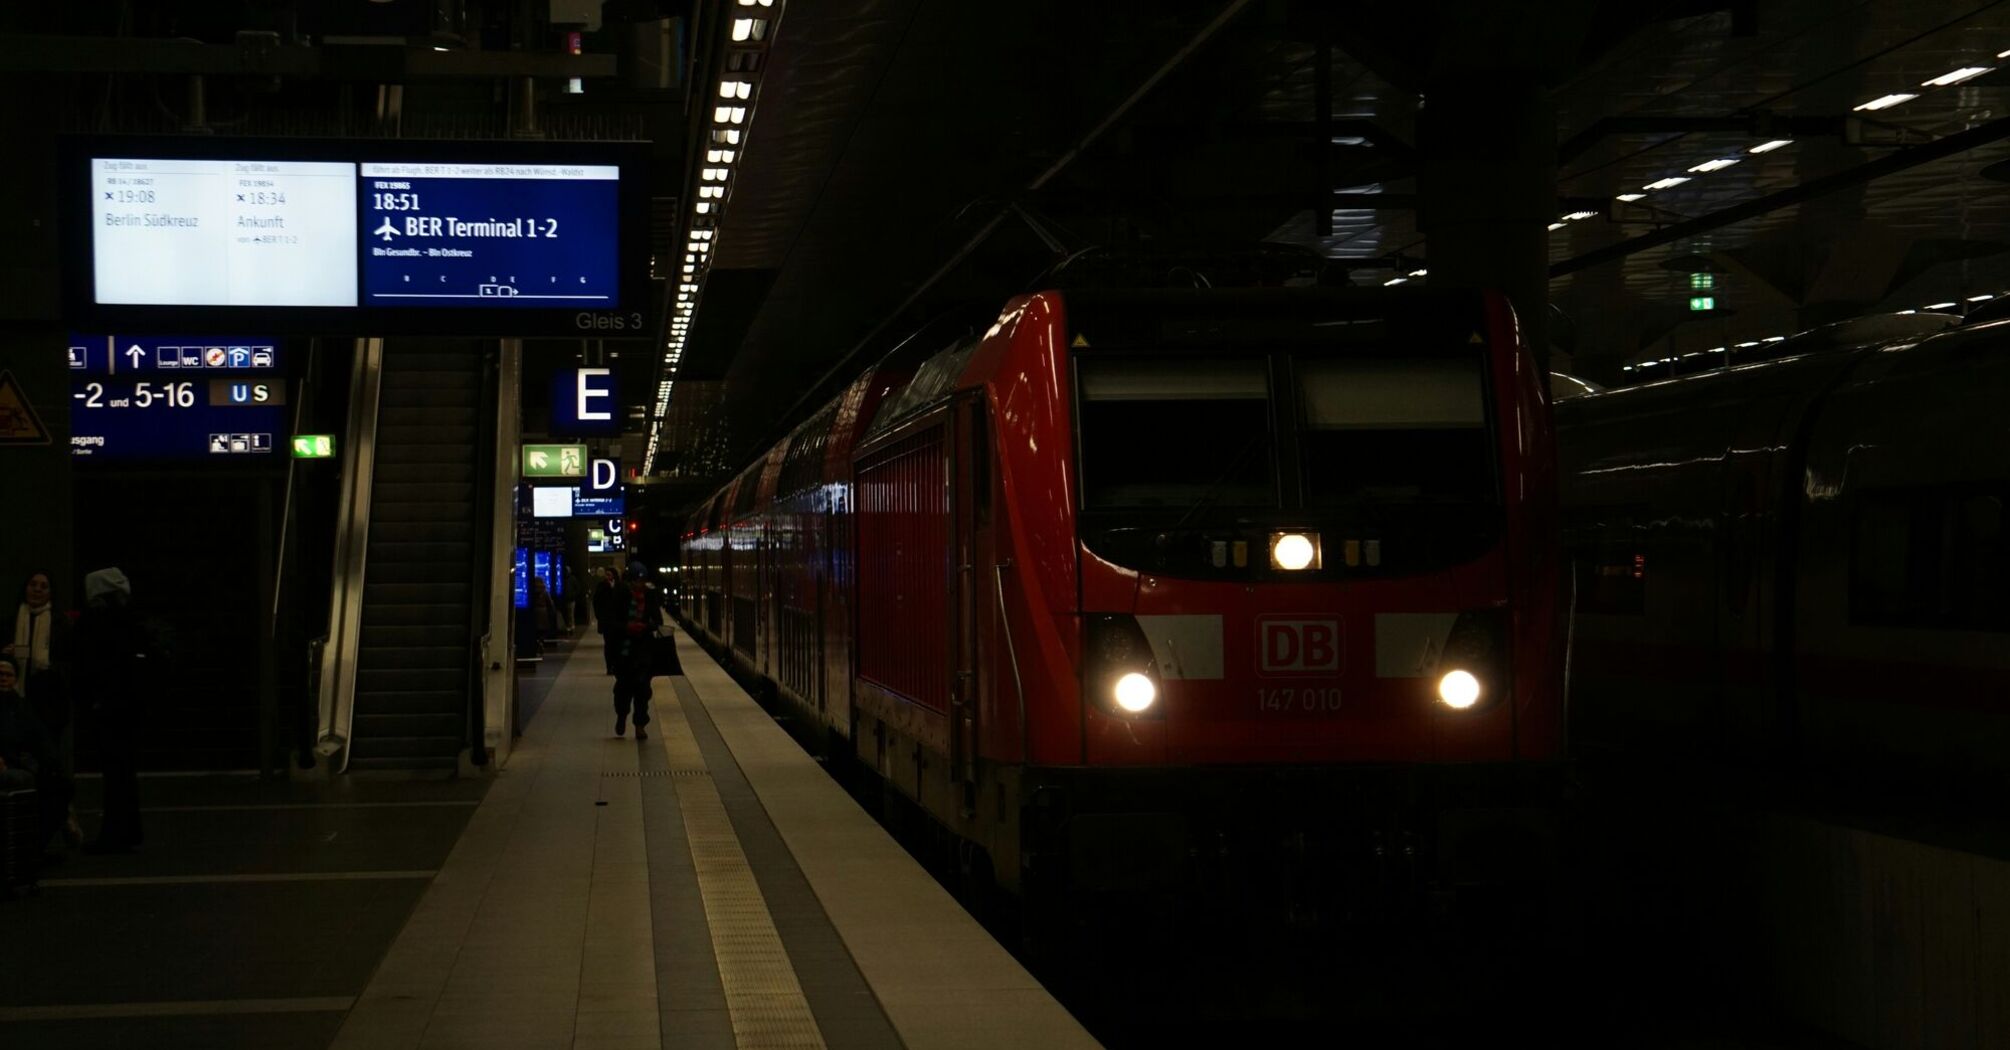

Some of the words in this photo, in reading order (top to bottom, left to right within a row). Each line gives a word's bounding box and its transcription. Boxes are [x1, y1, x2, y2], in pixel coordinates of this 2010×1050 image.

[117, 190, 156, 203] 19:08
[250, 192, 286, 205] 18:34
[373, 193, 420, 211] 18:51
[105, 213, 142, 226] Berlin
[143, 213, 199, 227] Südkreuz
[237, 215, 285, 229] Ankunft
[405, 217, 443, 237] BER
[446, 217, 522, 238] Terminal
[527, 218, 558, 239] 1-2
[575, 312, 625, 331] Gleis
[631, 312, 643, 330] 3
[183, 356, 199, 366] WC
[234, 353, 245, 367] P
[110, 396, 130, 408] und
[134, 382, 195, 408] 5-16
[232, 384, 247, 402] U
[253, 384, 270, 402] S
[576, 368, 612, 421] E
[592, 458, 617, 491] D
[608, 519, 621, 533] C
[1267, 625, 1334, 667] DB
[1257, 687, 1295, 711] 147
[1302, 687, 1342, 711] 010
